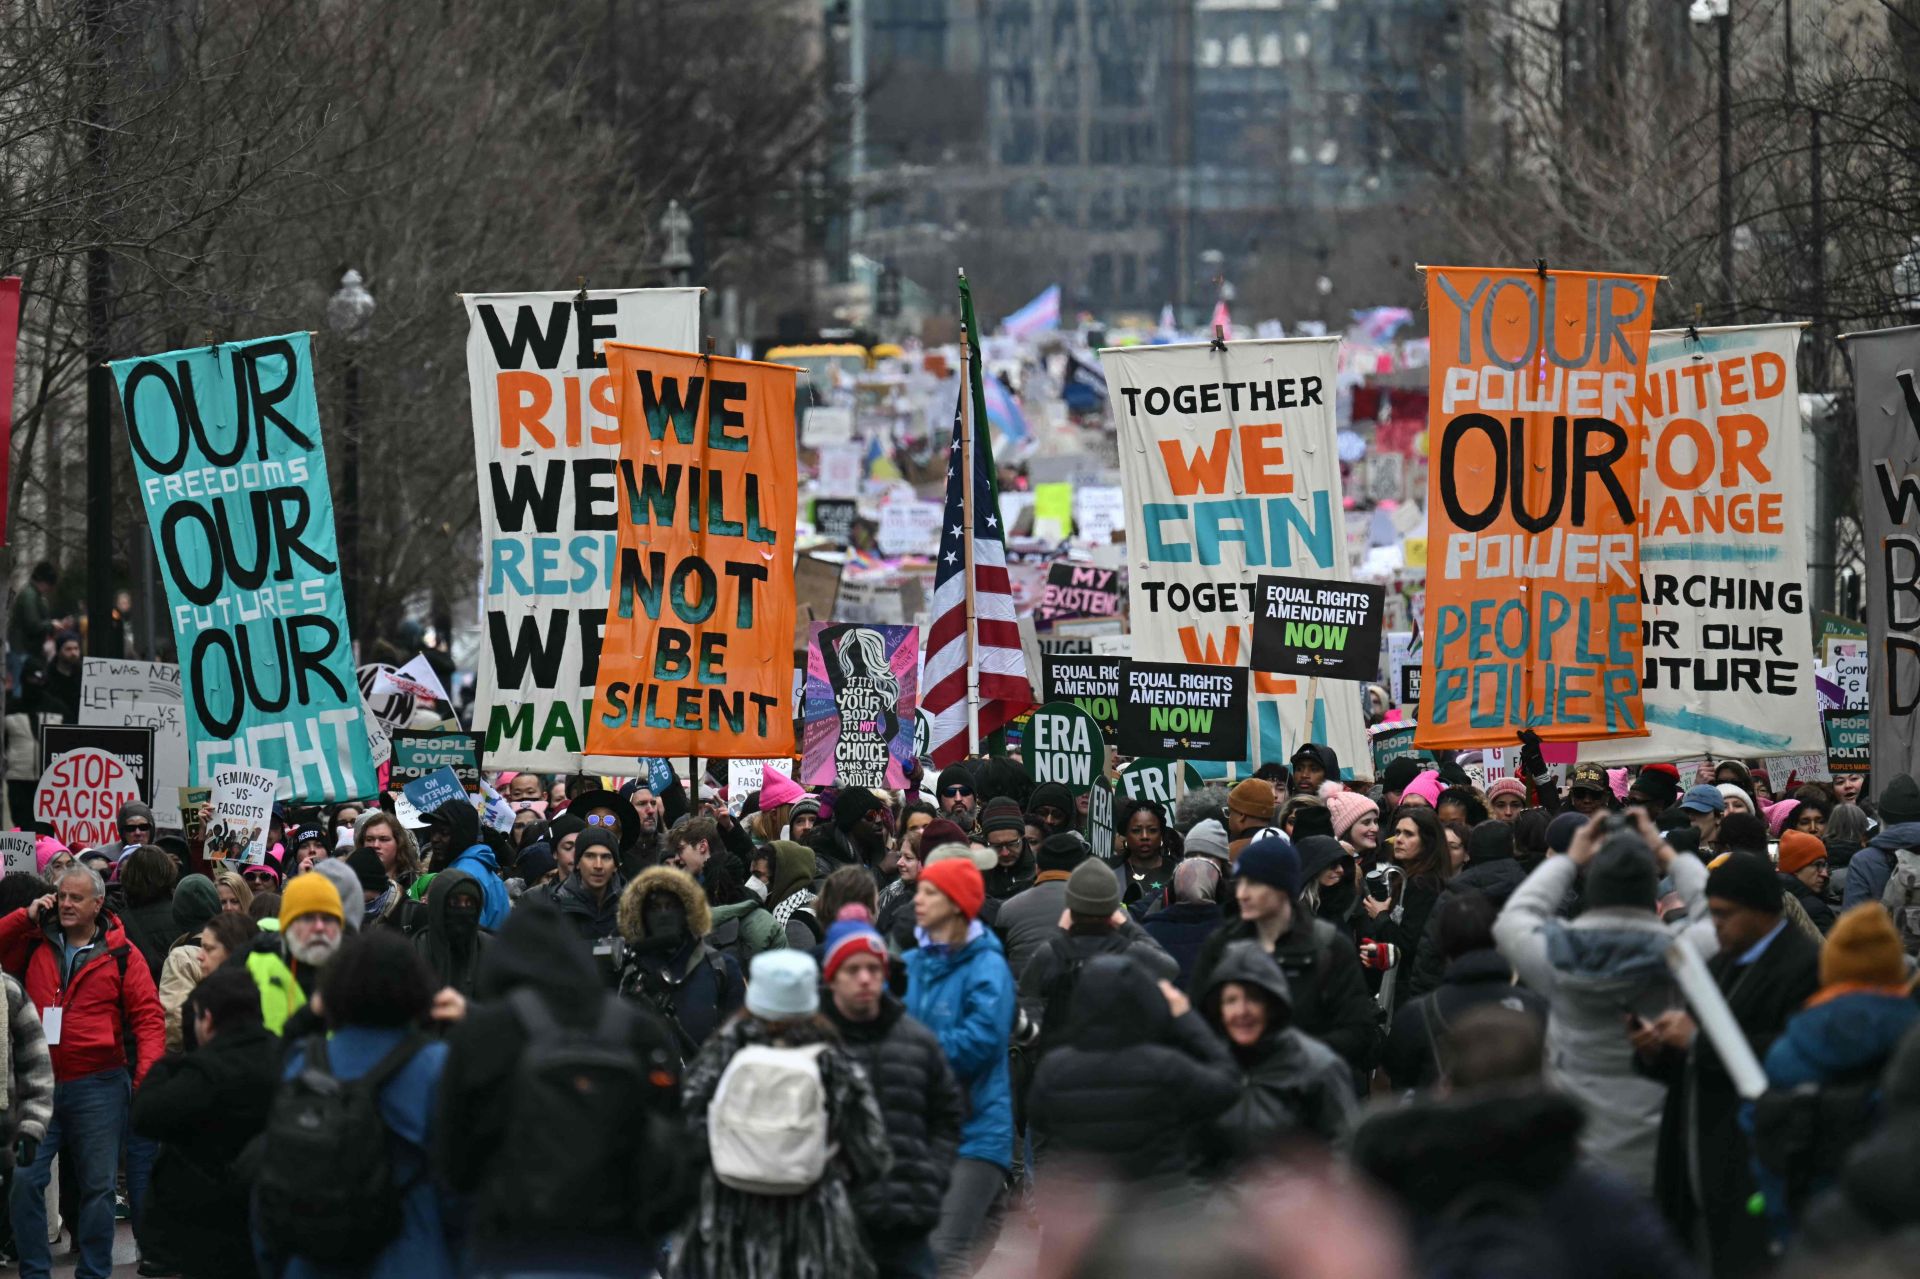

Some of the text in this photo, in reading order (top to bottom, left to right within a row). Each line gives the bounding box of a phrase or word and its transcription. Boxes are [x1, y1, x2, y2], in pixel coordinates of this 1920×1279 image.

[477, 299, 617, 369] WE
[1437, 274, 1648, 371] YOUR
[1121, 375, 1323, 417] TOGETHER
[1442, 366, 1637, 425] POWER
[1634, 351, 1787, 419] NITED
[124, 339, 314, 475] OUR
[497, 371, 621, 449] RIS
[637, 369, 749, 452] WE
[1158, 423, 1294, 497] WE
[1439, 412, 1636, 534] OUR
[144, 457, 309, 505] FREEDOMS
[488, 458, 619, 534] WE
[620, 459, 776, 545] WILL
[1638, 493, 1784, 539] HANGE
[1142, 490, 1335, 569] CAN
[161, 486, 337, 607] OUR
[1445, 529, 1636, 588] POWER
[488, 536, 616, 597] RESI
[1071, 567, 1112, 589] MY
[618, 549, 767, 629] NOT
[1042, 584, 1118, 616] EXISTEN
[1141, 581, 1257, 613] TOGET
[1266, 586, 1370, 609] EQUAL RIGHTS
[1640, 574, 1804, 615] RCHING
[174, 579, 326, 635] FUTURES
[1266, 603, 1368, 626] AMENDMENT
[1284, 622, 1348, 651] NOW
[1434, 591, 1637, 669] PEOPLE
[1640, 620, 1783, 656] OR OUR
[488, 607, 608, 690] WE
[653, 627, 727, 684] BE
[110, 664, 140, 676] WAS
[149, 664, 181, 686] NEVE
[191, 614, 348, 740] OUR
[1052, 664, 1119, 681] EQUAL RIG
[1129, 671, 1233, 691] EQUAL RIGHTS
[1641, 656, 1799, 697] UTURE
[1836, 658, 1867, 674] Conv
[84, 685, 143, 711] LEFT
[842, 688, 874, 697] NOT
[846, 677, 857, 688] IF
[1054, 681, 1119, 696] AMENDM
[1130, 689, 1231, 708] AMENDMENT
[1433, 662, 1640, 733] POWER
[158, 706, 175, 721] VS
[601, 682, 778, 737] SILENT
[836, 694, 880, 710] YOUR
[841, 709, 878, 721] BODY
[483, 701, 591, 752] MA
[860, 721, 876, 731] NOT
[1035, 713, 1091, 752] ERA
[1150, 706, 1213, 733] NOW
[402, 737, 476, 751] PEOPLE
[836, 742, 888, 762] CHOICE
[840, 732, 881, 741] YOUR
[1376, 736, 1416, 751] PEOPL
[1829, 747, 1869, 758] POLITI
[52, 754, 123, 789] STOP
[392, 766, 479, 779] POLCS
[412, 753, 464, 765] OVER
[836, 761, 886, 772] BANS OFF
[1035, 751, 1091, 785] NOW
[216, 771, 274, 793] FEMINISTS
[738, 778, 762, 788] FASC
[839, 771, 883, 788] BODIES
[38, 789, 135, 819] RACISM
[217, 802, 264, 819] FASCISTS
[1093, 784, 1112, 829] ERA
[0, 838, 34, 857] MINISTS
[298, 830, 319, 843] RESIST
[1092, 822, 1112, 860] NOW
[4, 854, 18, 867] VS-
